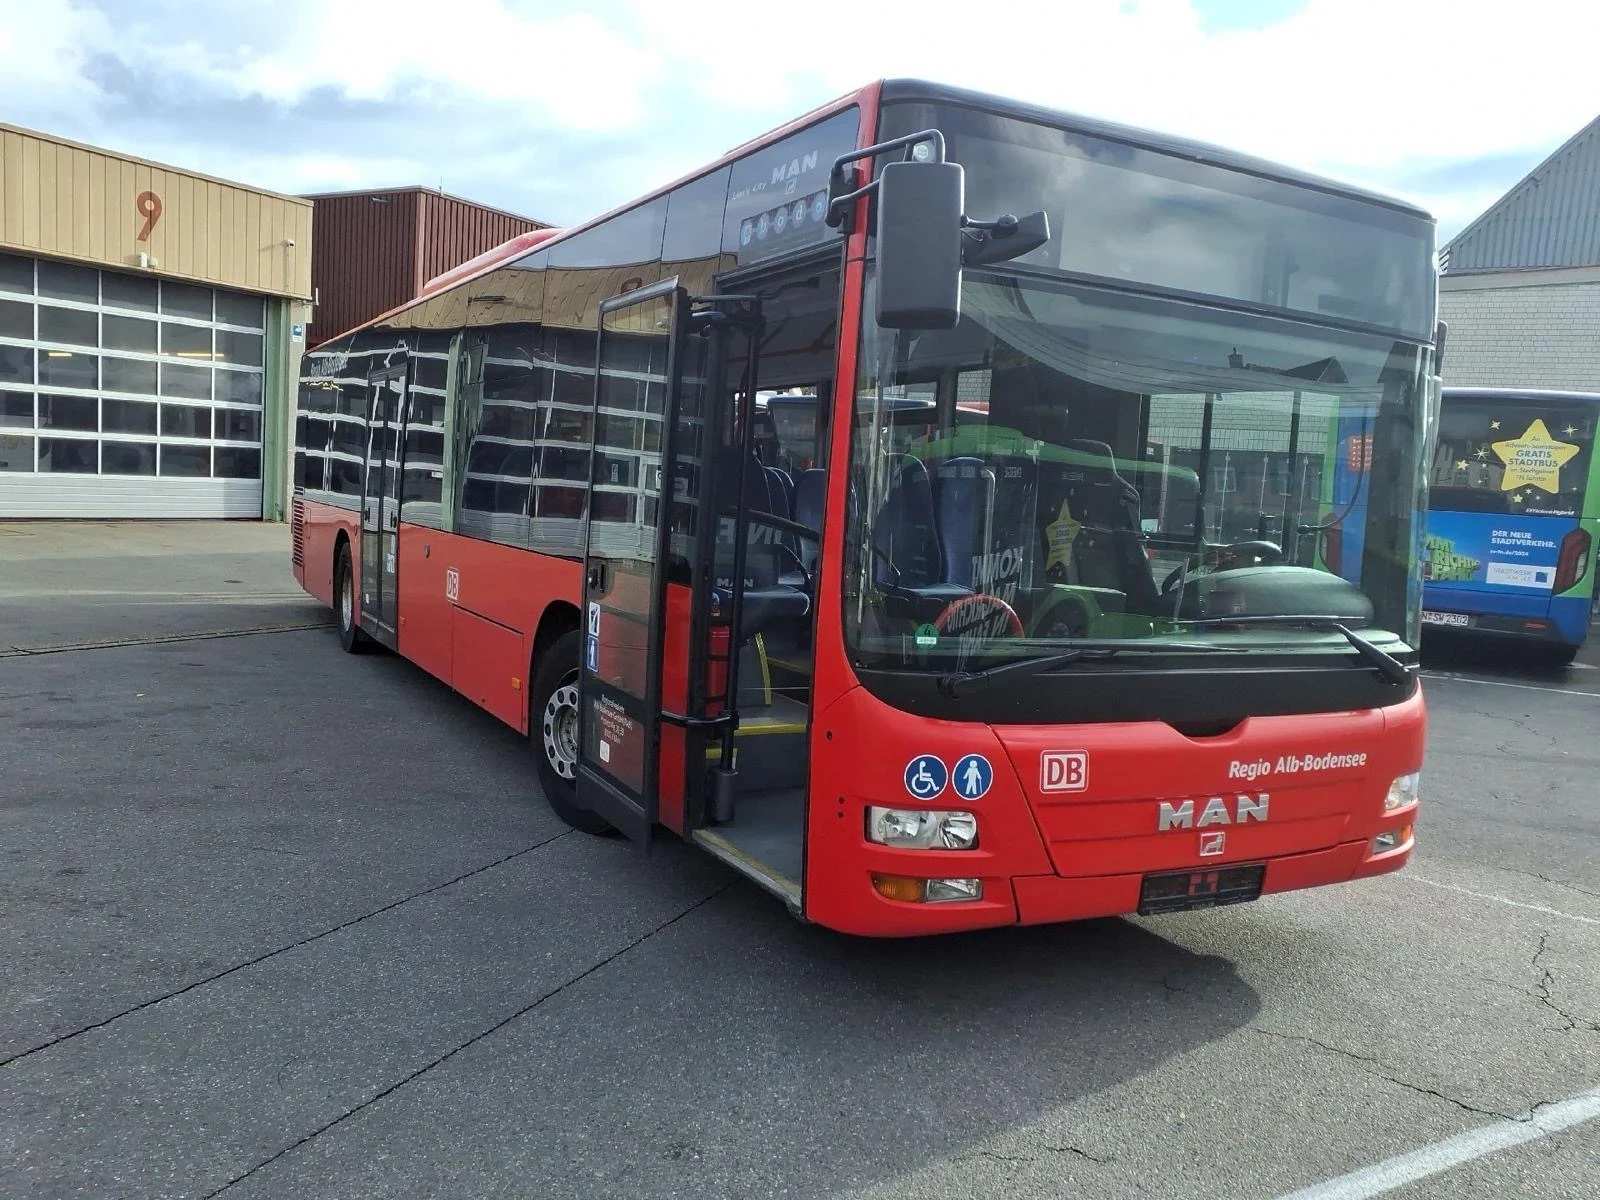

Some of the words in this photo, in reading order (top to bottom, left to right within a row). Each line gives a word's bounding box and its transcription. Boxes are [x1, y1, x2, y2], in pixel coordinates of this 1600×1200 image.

[771, 150, 818, 185] MAN
[137, 191, 162, 241] 9
[1508, 458, 1558, 467] STADTBUS
[1516, 449, 1552, 458] GRATIS
[1491, 537, 1557, 548] STADTVERKEHR.
[1510, 531, 1532, 539] NEUE
[447, 573, 458, 599] DB
[1046, 756, 1082, 787] DB
[1229, 759, 1271, 779] Regio
[1274, 752, 1367, 774] Alb-Bodensee
[1158, 793, 1270, 832] MAN
